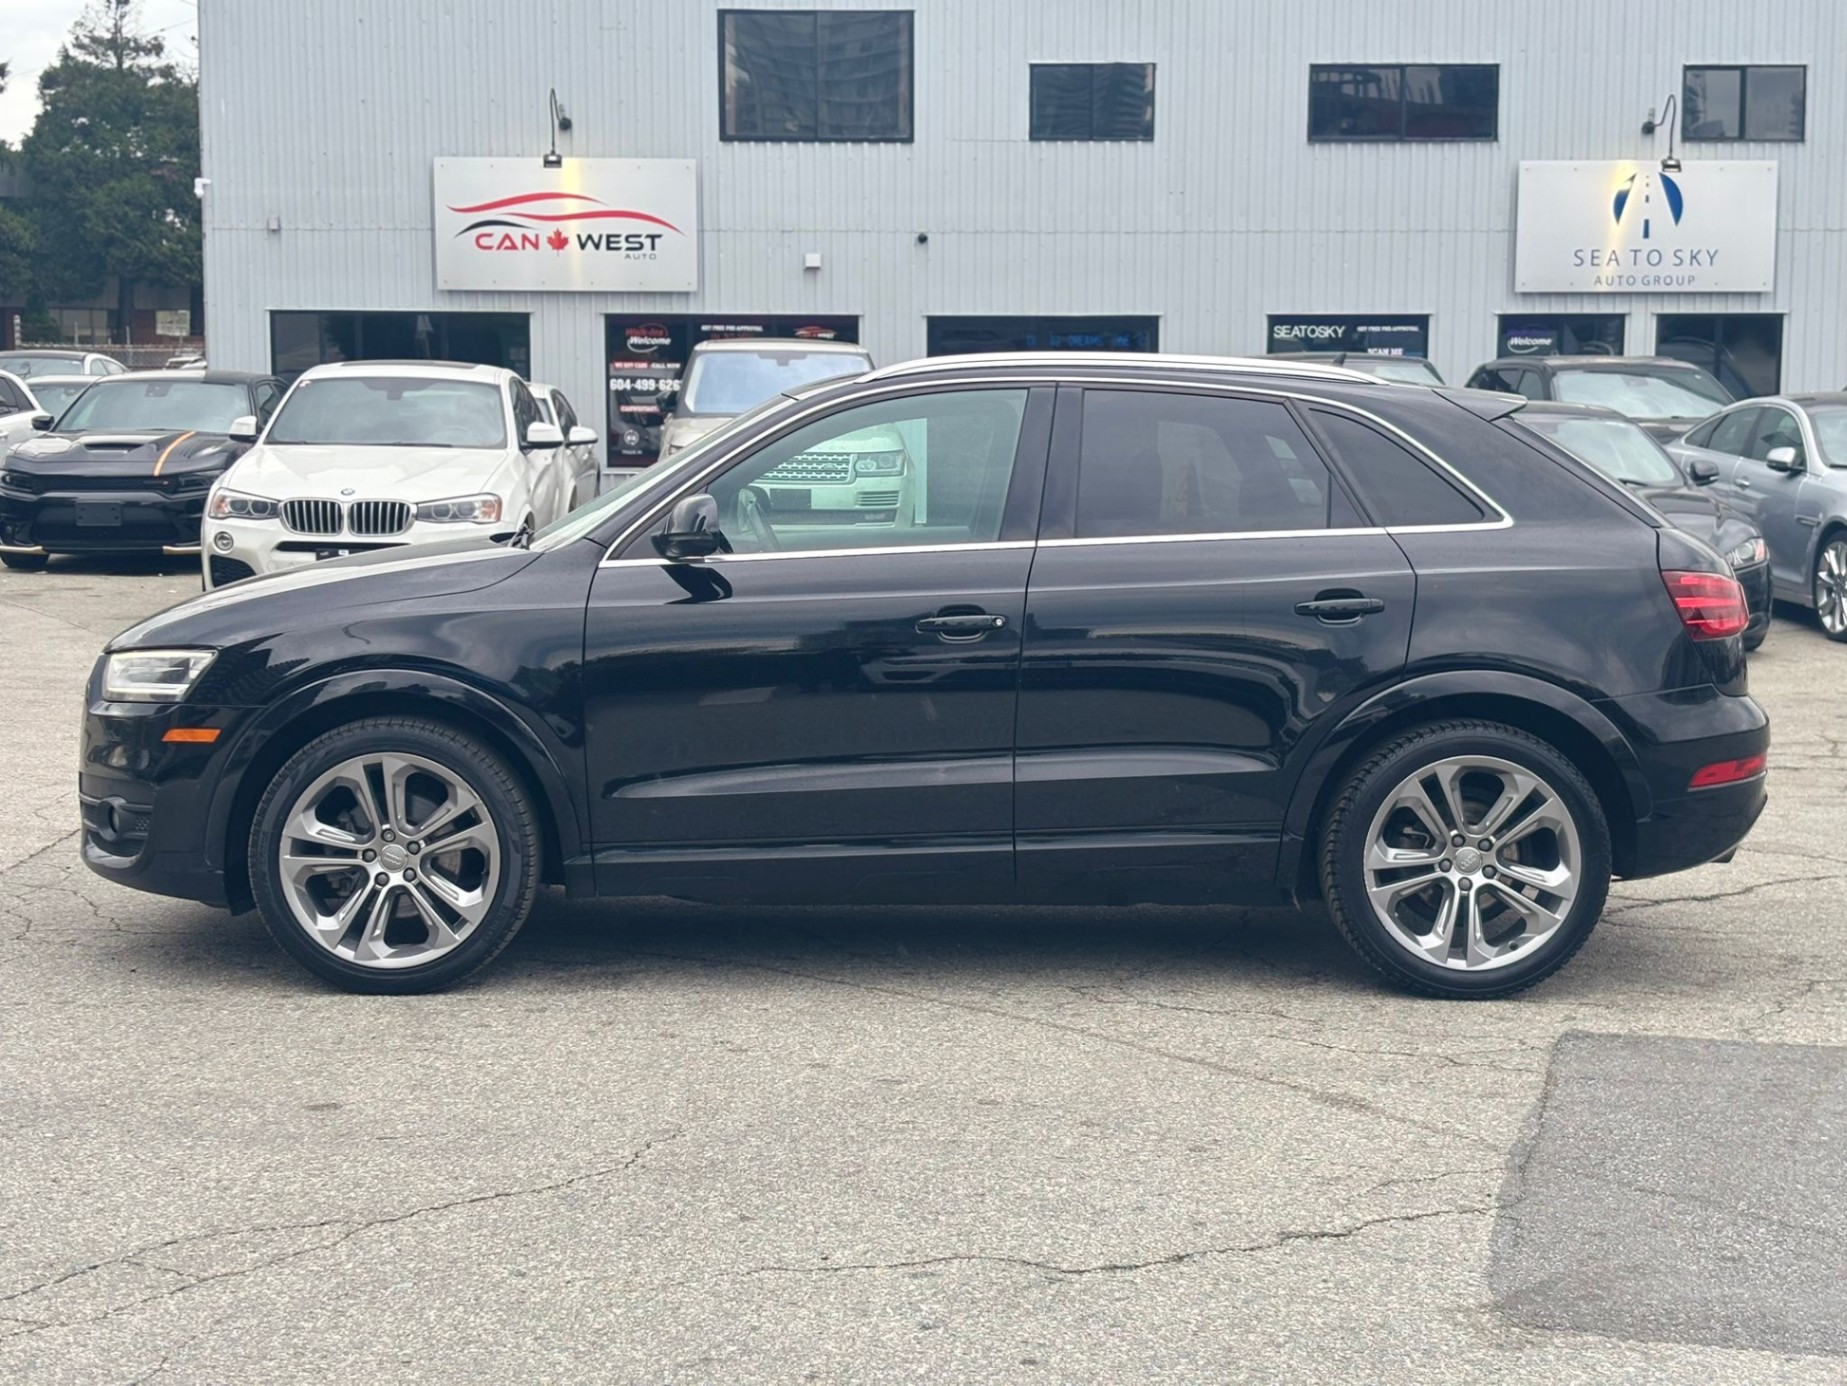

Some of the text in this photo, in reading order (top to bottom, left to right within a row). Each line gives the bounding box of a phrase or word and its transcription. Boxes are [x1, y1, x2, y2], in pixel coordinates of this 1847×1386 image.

[475, 233, 663, 251] CAN WEST
[1573, 249, 1719, 267] SEA TO SKY
[1593, 275, 1696, 286] AUTO GROUP
[1273, 325, 1346, 338] SEATOSKY
[629, 336, 672, 346] Welcome
[1510, 336, 1552, 346] Welcome
[610, 378, 682, 391] 604-499-626
